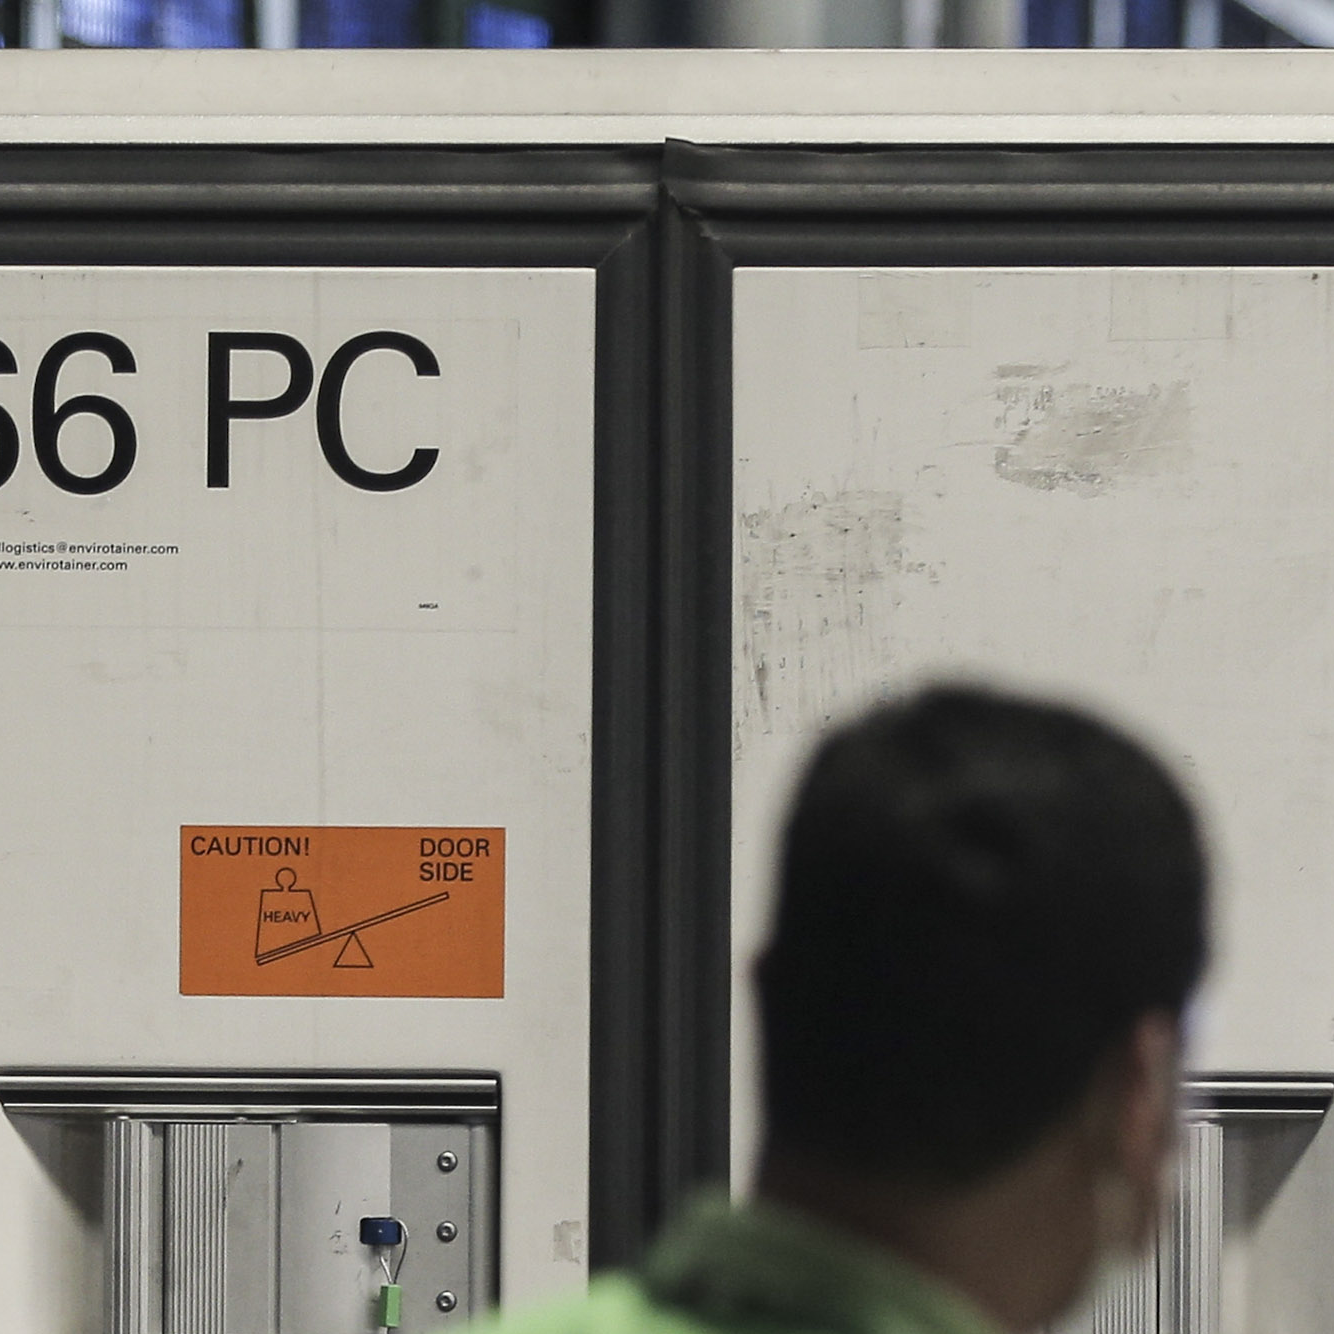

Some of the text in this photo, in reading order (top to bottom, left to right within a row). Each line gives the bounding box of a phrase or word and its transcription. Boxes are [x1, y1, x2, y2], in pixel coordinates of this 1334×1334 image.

[207, 331, 440, 492] PC
[190, 835, 309, 857] CAUTION!
[420, 837, 490, 858] DOOR
[419, 861, 474, 882] SIDE
[263, 910, 311, 923] HEAVY
